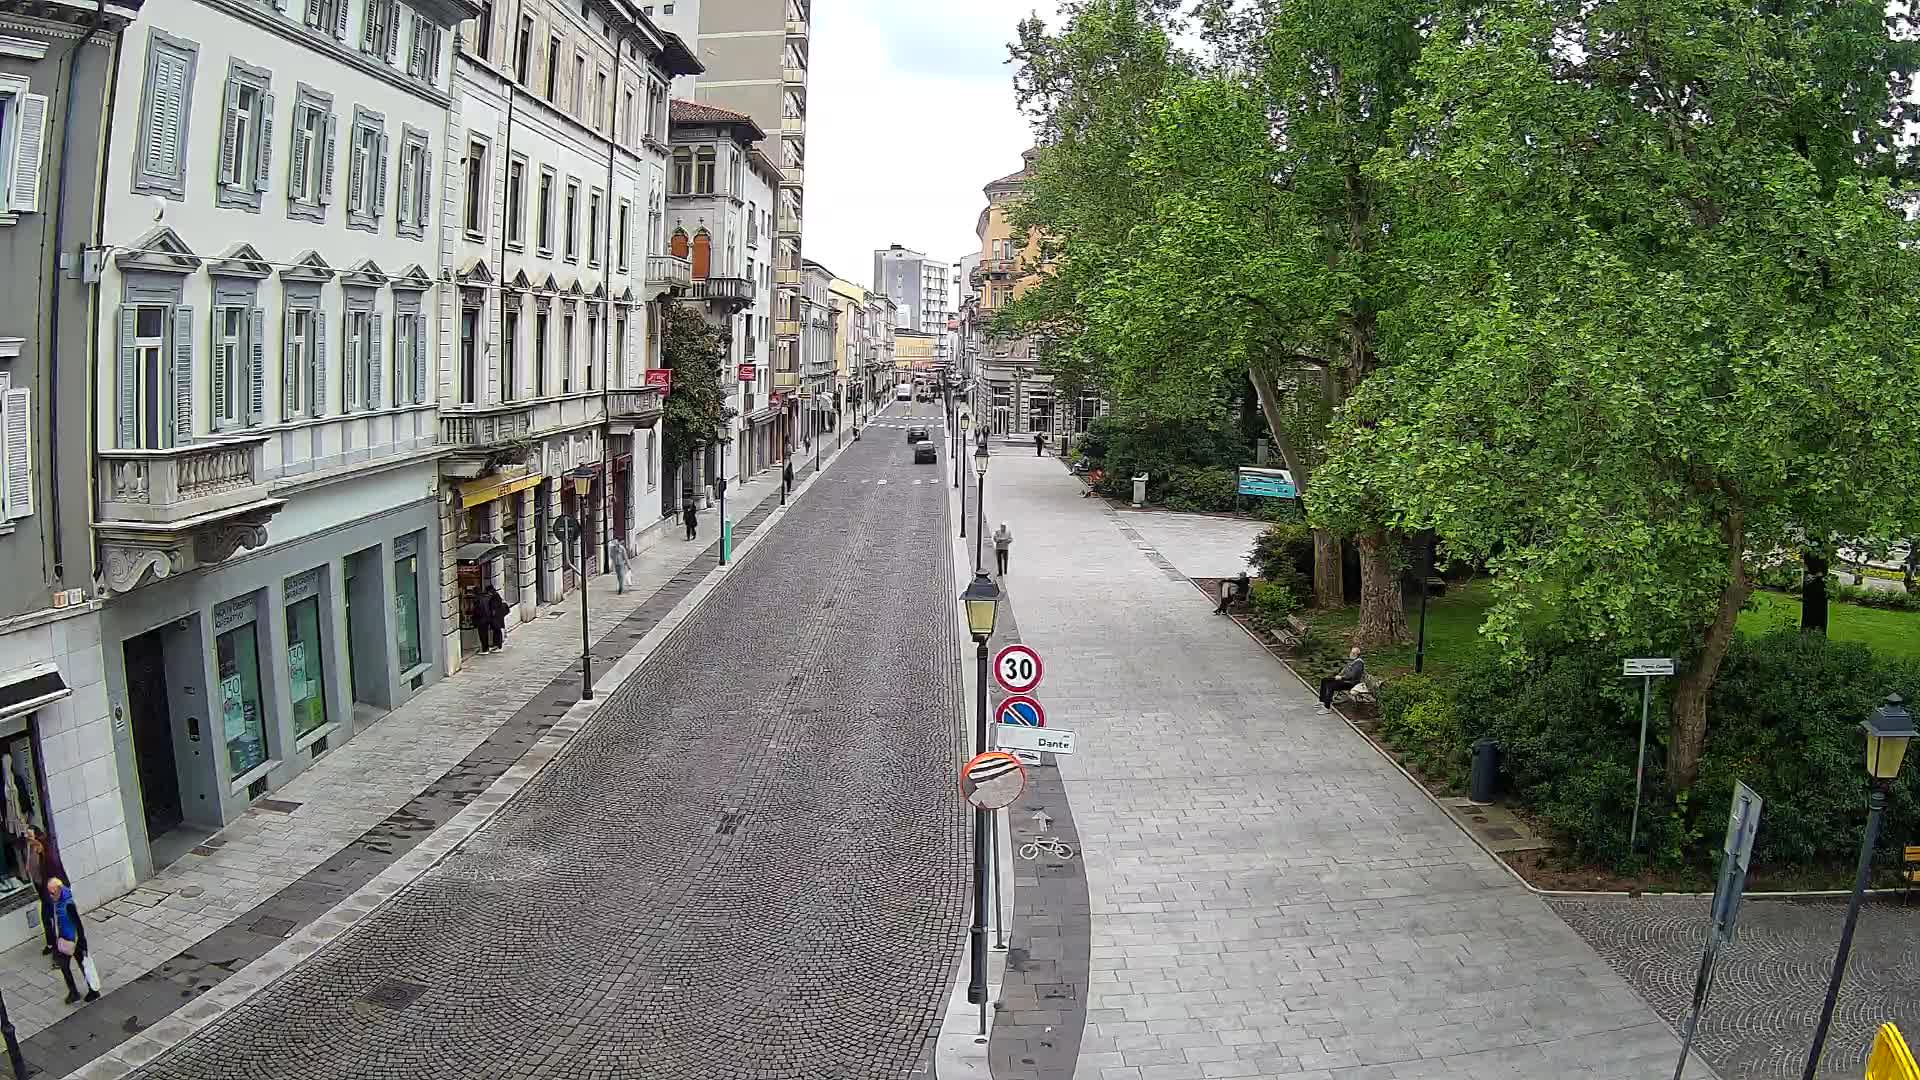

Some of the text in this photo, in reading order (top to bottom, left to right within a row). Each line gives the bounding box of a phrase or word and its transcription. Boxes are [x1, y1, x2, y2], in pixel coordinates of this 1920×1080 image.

[1005, 658, 1033, 680] 30
[222, 678, 240, 701] 130
[1038, 738, 1070, 749] Dante
